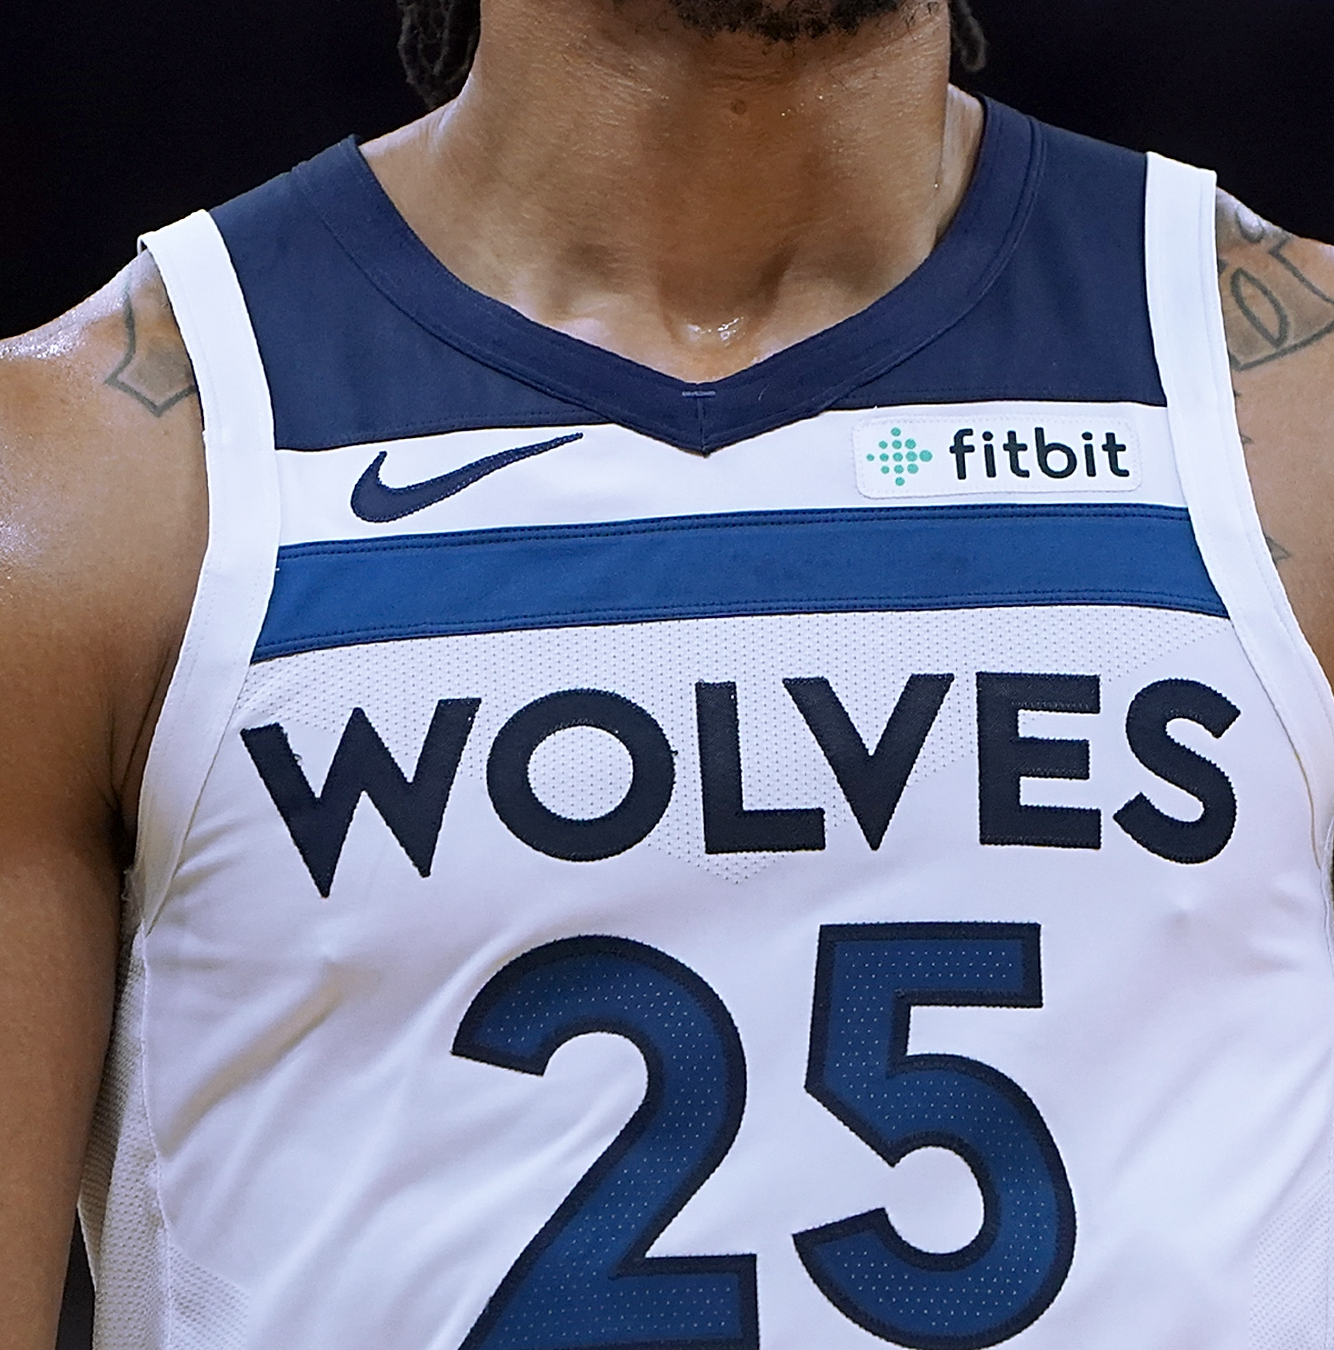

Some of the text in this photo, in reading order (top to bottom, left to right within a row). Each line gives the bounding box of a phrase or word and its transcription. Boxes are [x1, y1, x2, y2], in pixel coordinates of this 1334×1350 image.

[949, 427, 1130, 480] fitbit
[240, 671, 1241, 897] WOLVES
[450, 921, 1077, 1350] 25
